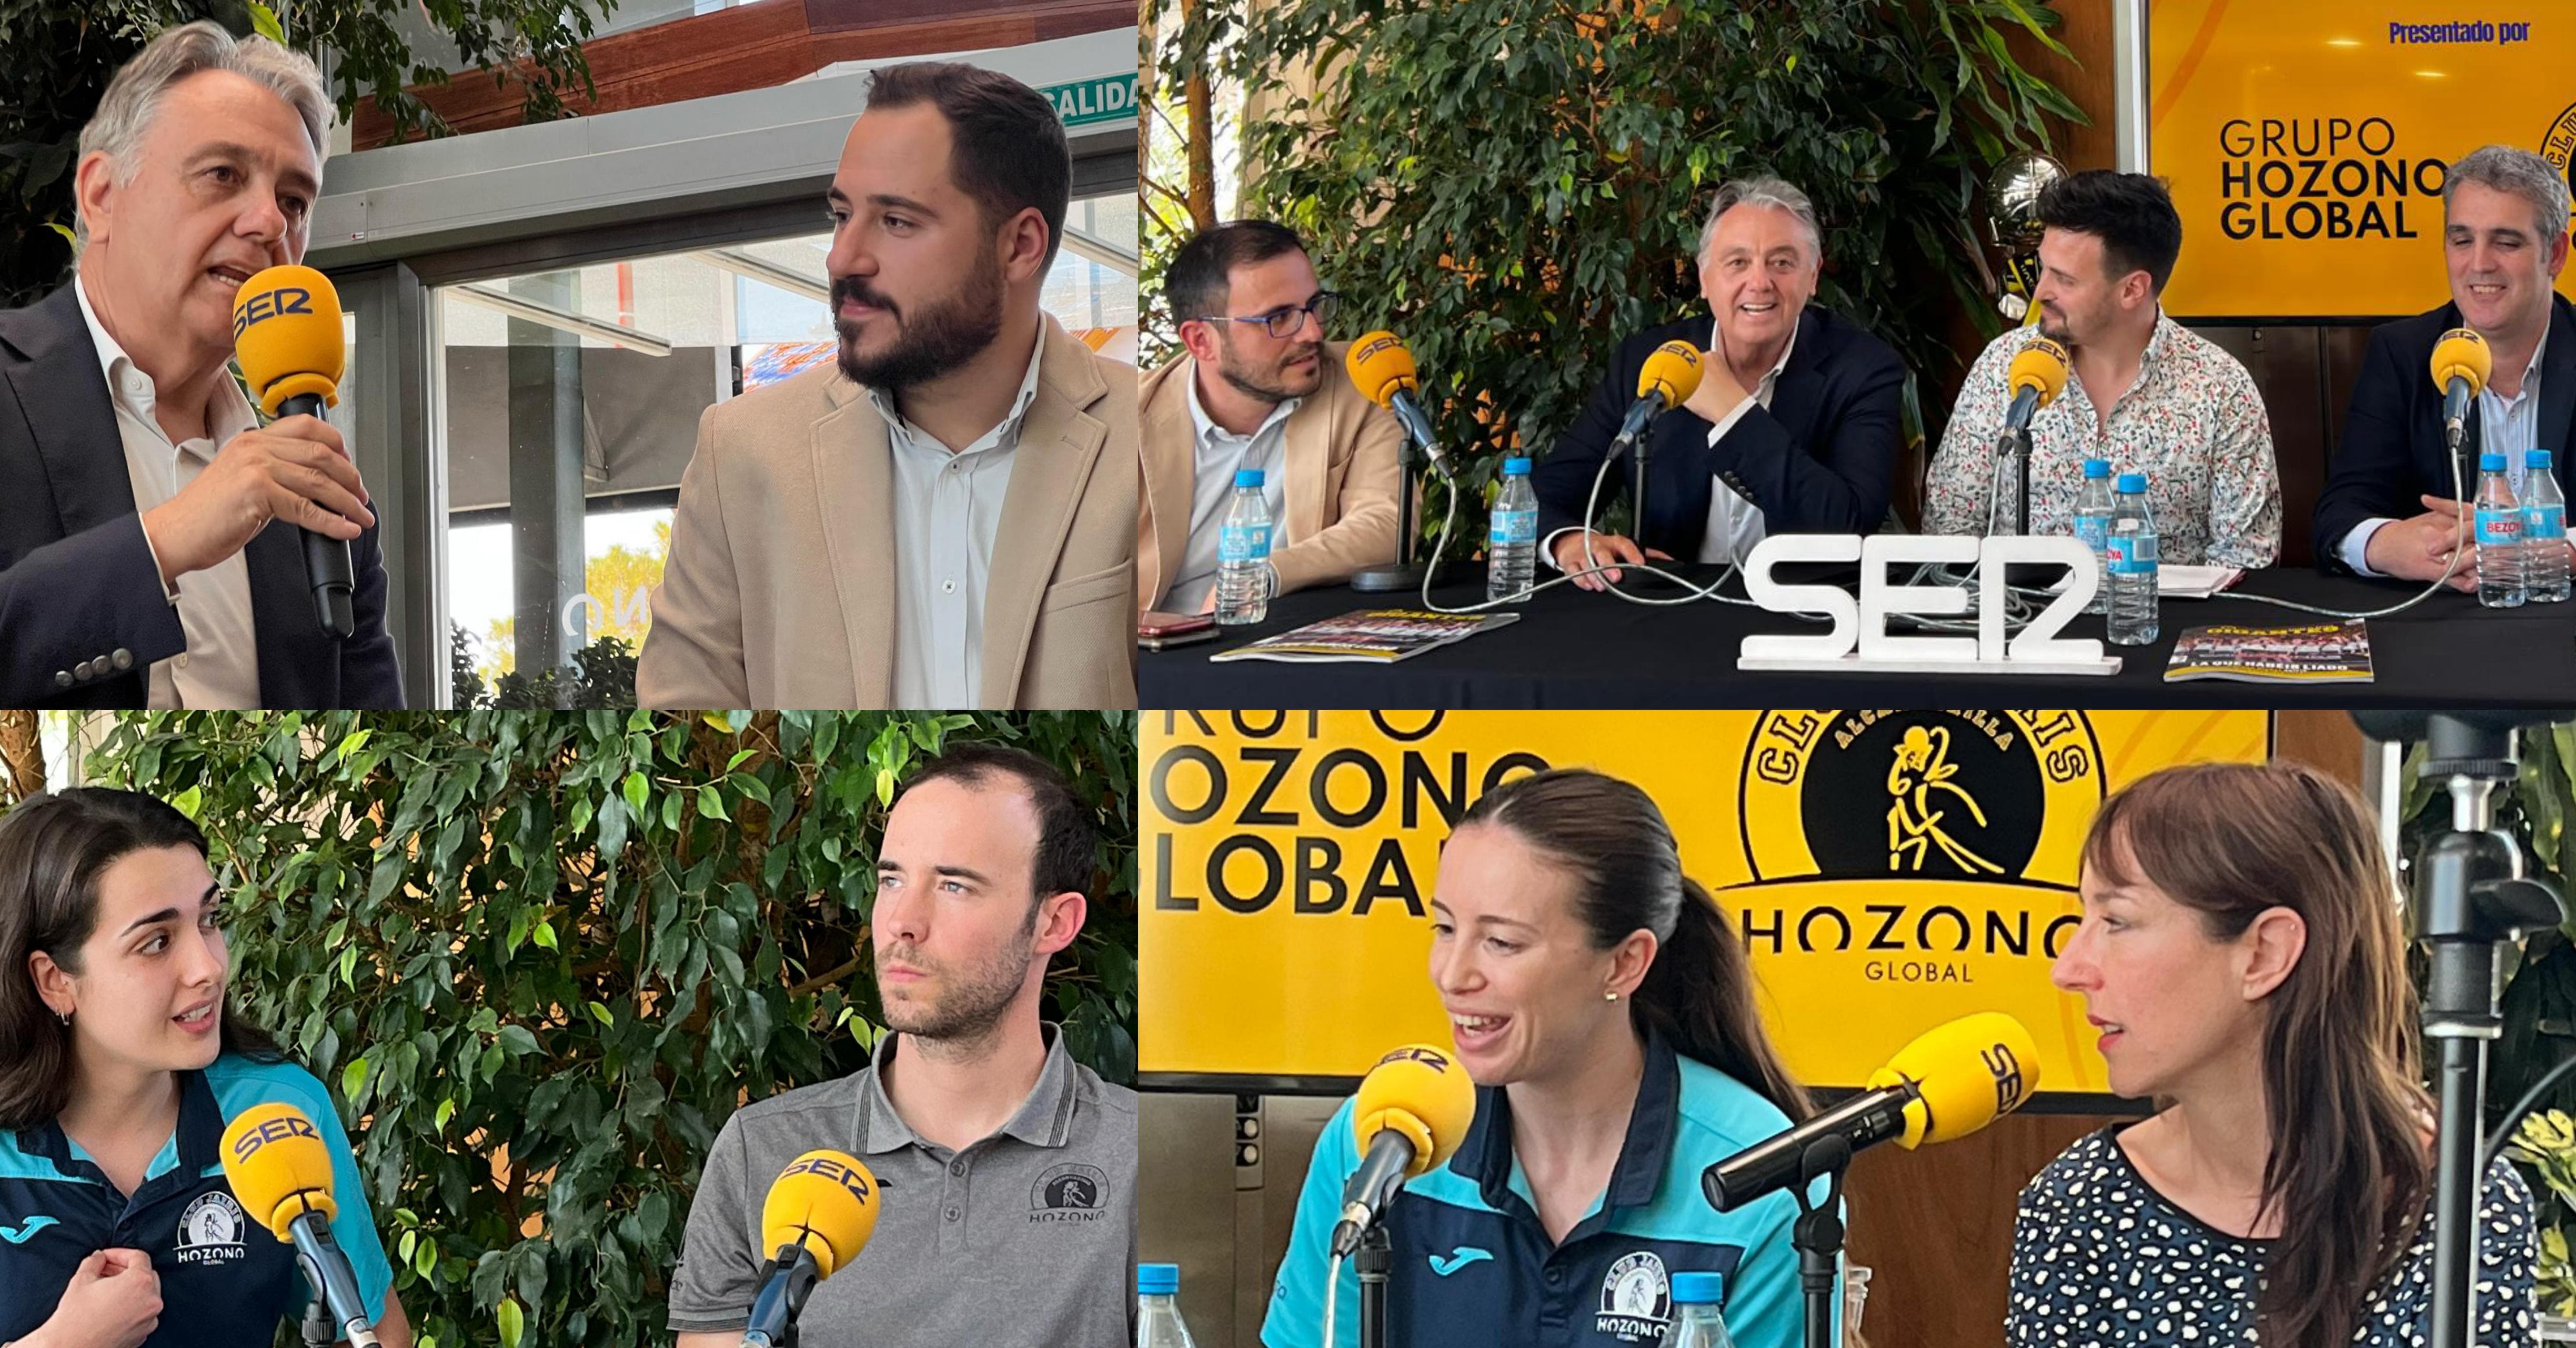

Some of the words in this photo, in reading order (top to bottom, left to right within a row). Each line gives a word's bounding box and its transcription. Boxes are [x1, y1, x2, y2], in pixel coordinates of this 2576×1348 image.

[2389, 21, 2494, 43] Presentado
[2499, 23, 2530, 44] por
[2220, 117, 2394, 157] GRUPO
[2222, 158, 2450, 198] HOZONO
[2221, 201, 2417, 239] GLOBAL
[234, 288, 313, 340] SER
[1741, 535, 2104, 662] SER
[1865, 961, 1974, 983] GLOBAL
[235, 1118, 319, 1164] SER
[780, 1159, 869, 1205] SER
[1030, 1210, 1105, 1223] HOZONO
[178, 1248, 244, 1263] HOZONO
